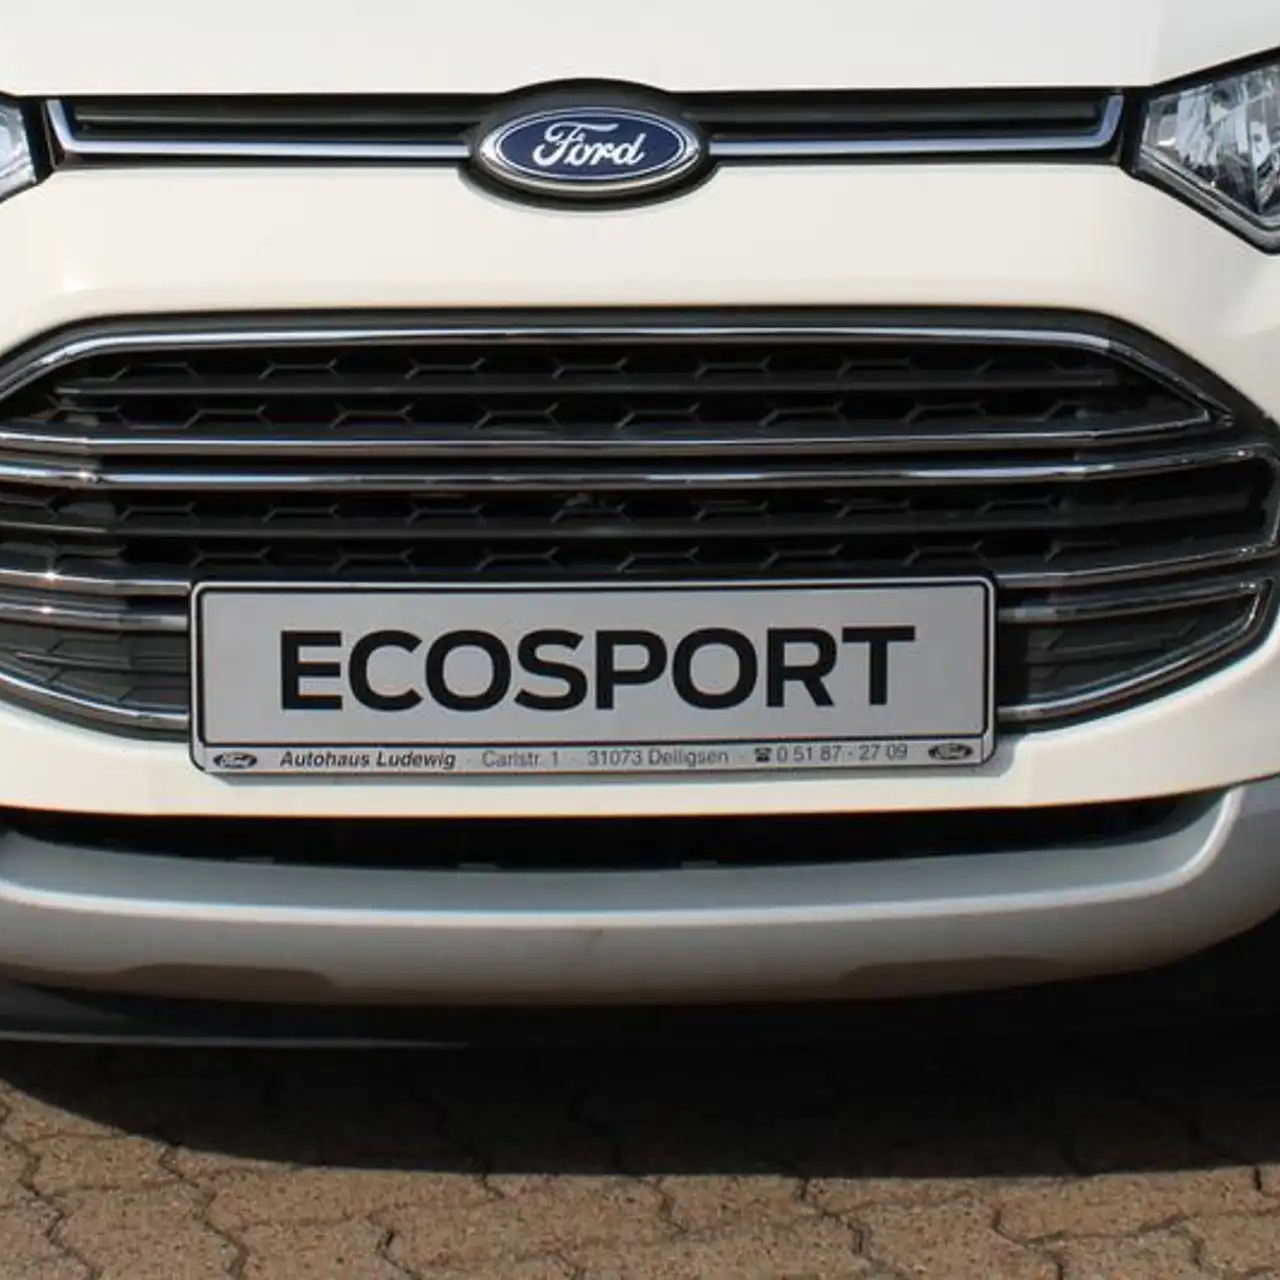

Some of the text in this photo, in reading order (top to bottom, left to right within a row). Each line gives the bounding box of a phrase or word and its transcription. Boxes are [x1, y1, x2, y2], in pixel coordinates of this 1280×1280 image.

[532, 121, 647, 167] Ford
[280, 626, 916, 711] ECOSPORT
[279, 751, 370, 768] Autohaus
[376, 751, 456, 769] Ludewig
[587, 749, 642, 766] 31073
[776, 747, 787, 762] 0
[794, 746, 812, 761] 51
[820, 745, 842, 761] 87
[859, 744, 879, 761] 27
